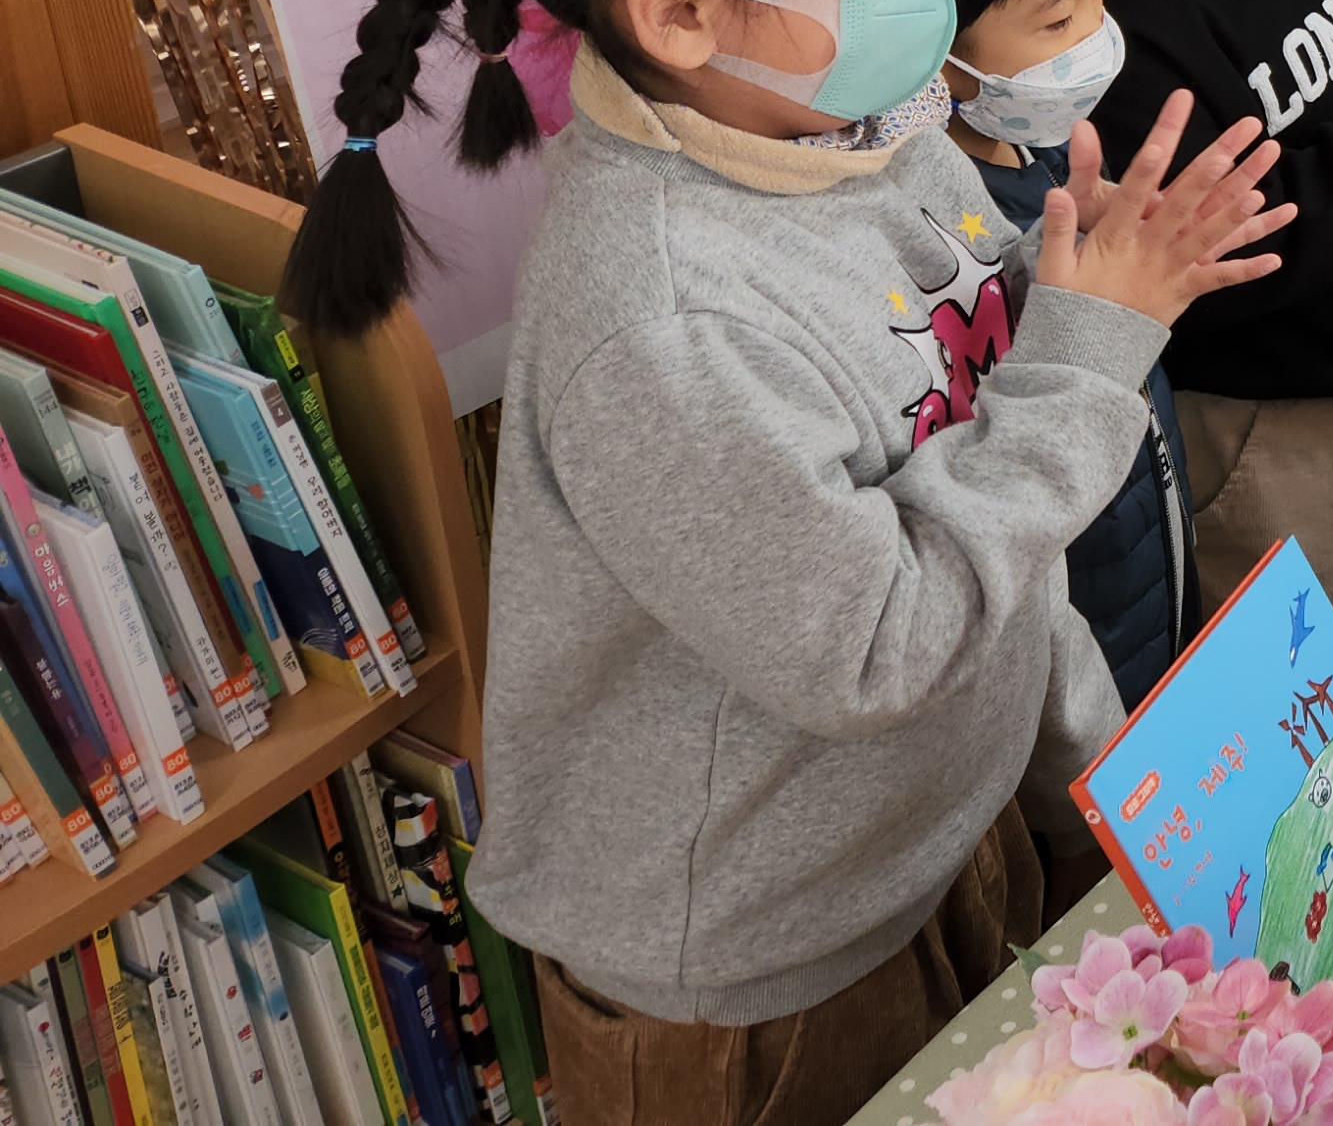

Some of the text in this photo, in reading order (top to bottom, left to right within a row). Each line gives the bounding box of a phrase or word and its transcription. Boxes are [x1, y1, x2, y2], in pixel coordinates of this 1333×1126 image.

[152, 350, 169, 377] 그리고
[165, 381, 188, 424] 사람들은
[56, 443, 80, 473] 내가
[307, 476, 343, 539] 우리 할아버지
[35, 543, 69, 607] 마음버스
[1143, 731, 1249, 871] 안녕, 제주!
